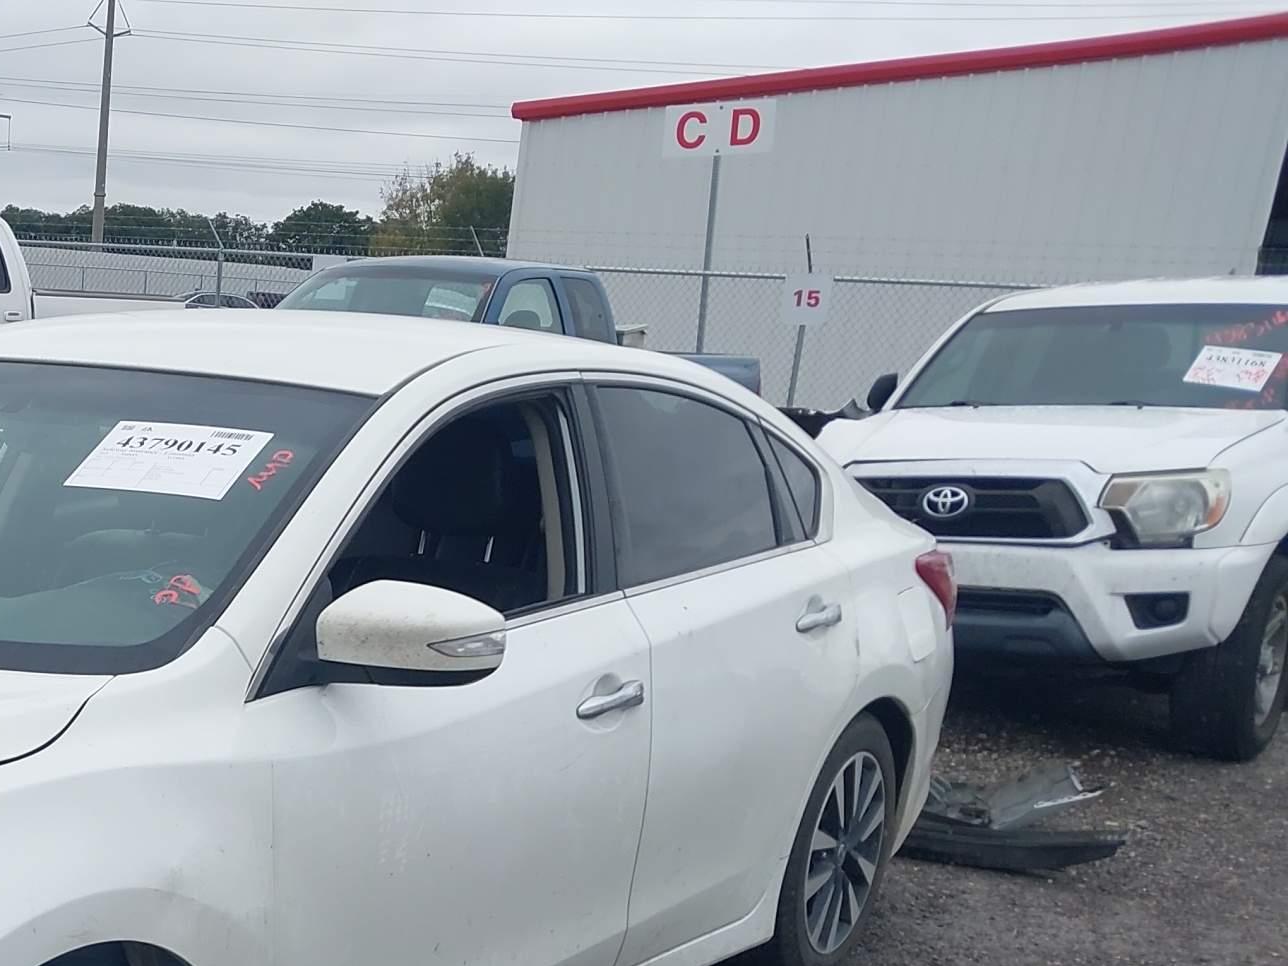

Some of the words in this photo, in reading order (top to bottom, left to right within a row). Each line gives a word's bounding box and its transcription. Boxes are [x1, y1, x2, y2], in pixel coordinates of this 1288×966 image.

[676, 111, 708, 149] C
[729, 108, 761, 146] D
[793, 290, 821, 308] 15
[116, 435, 243, 457] 43790145
